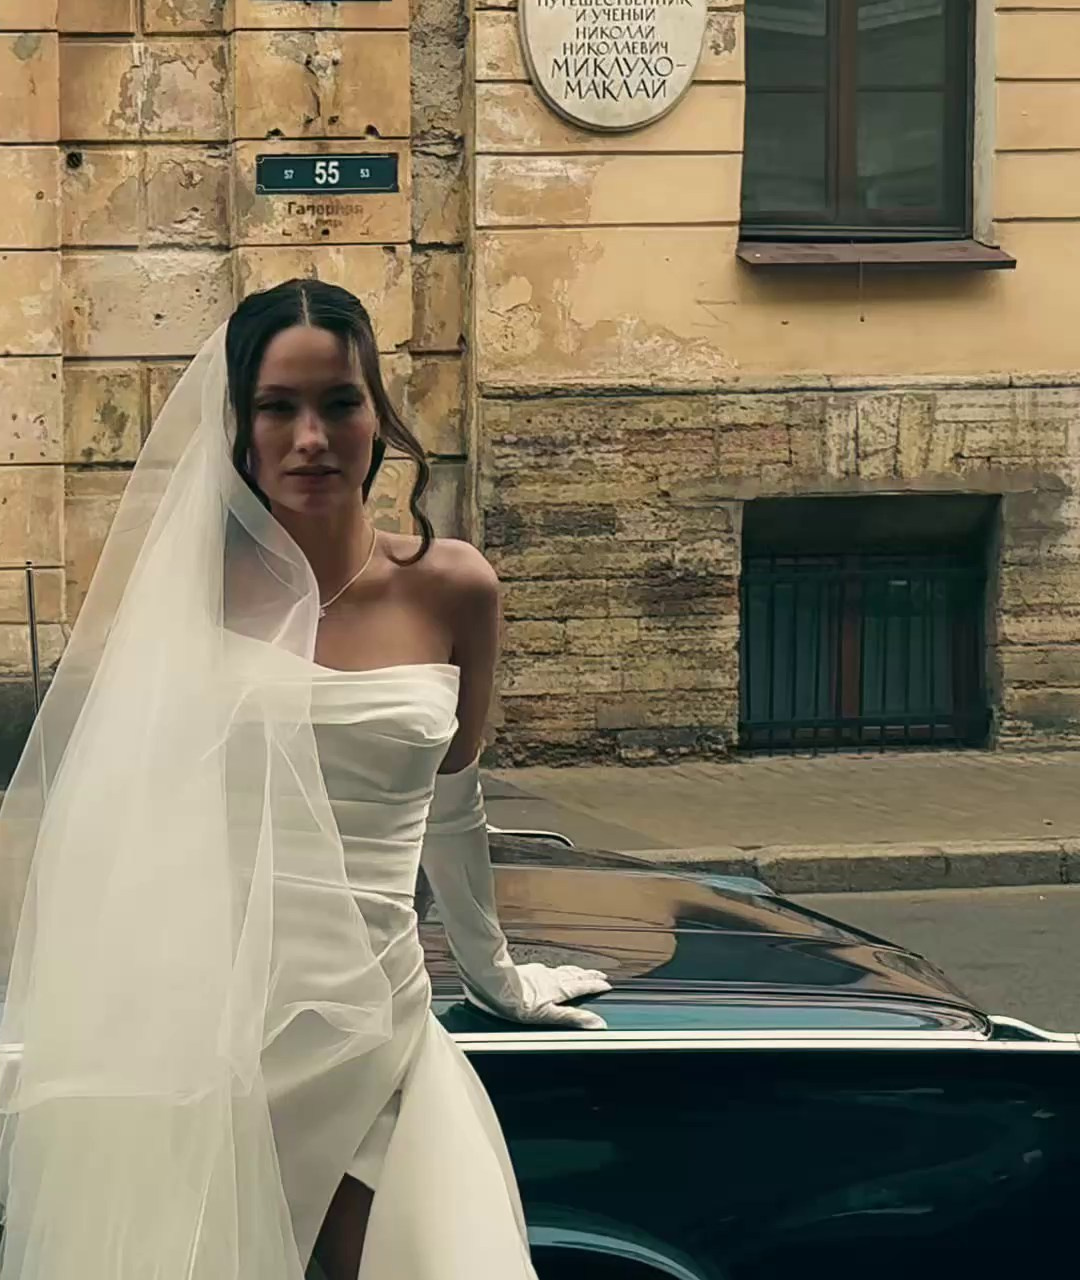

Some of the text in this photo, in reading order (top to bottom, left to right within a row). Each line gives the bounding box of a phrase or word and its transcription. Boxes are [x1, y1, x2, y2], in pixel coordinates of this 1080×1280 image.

[576, 7, 656, 23] И УЧЕНЫЙ
[576, 25, 655, 40] НИКОЛАЙ
[563, 41, 668, 56] НИКОЛАЕВИЧ
[551, 56, 687, 79] МИКЛУХО-
[564, 79, 667, 102] МАКЛАЙ
[314, 161, 340, 185] 55
